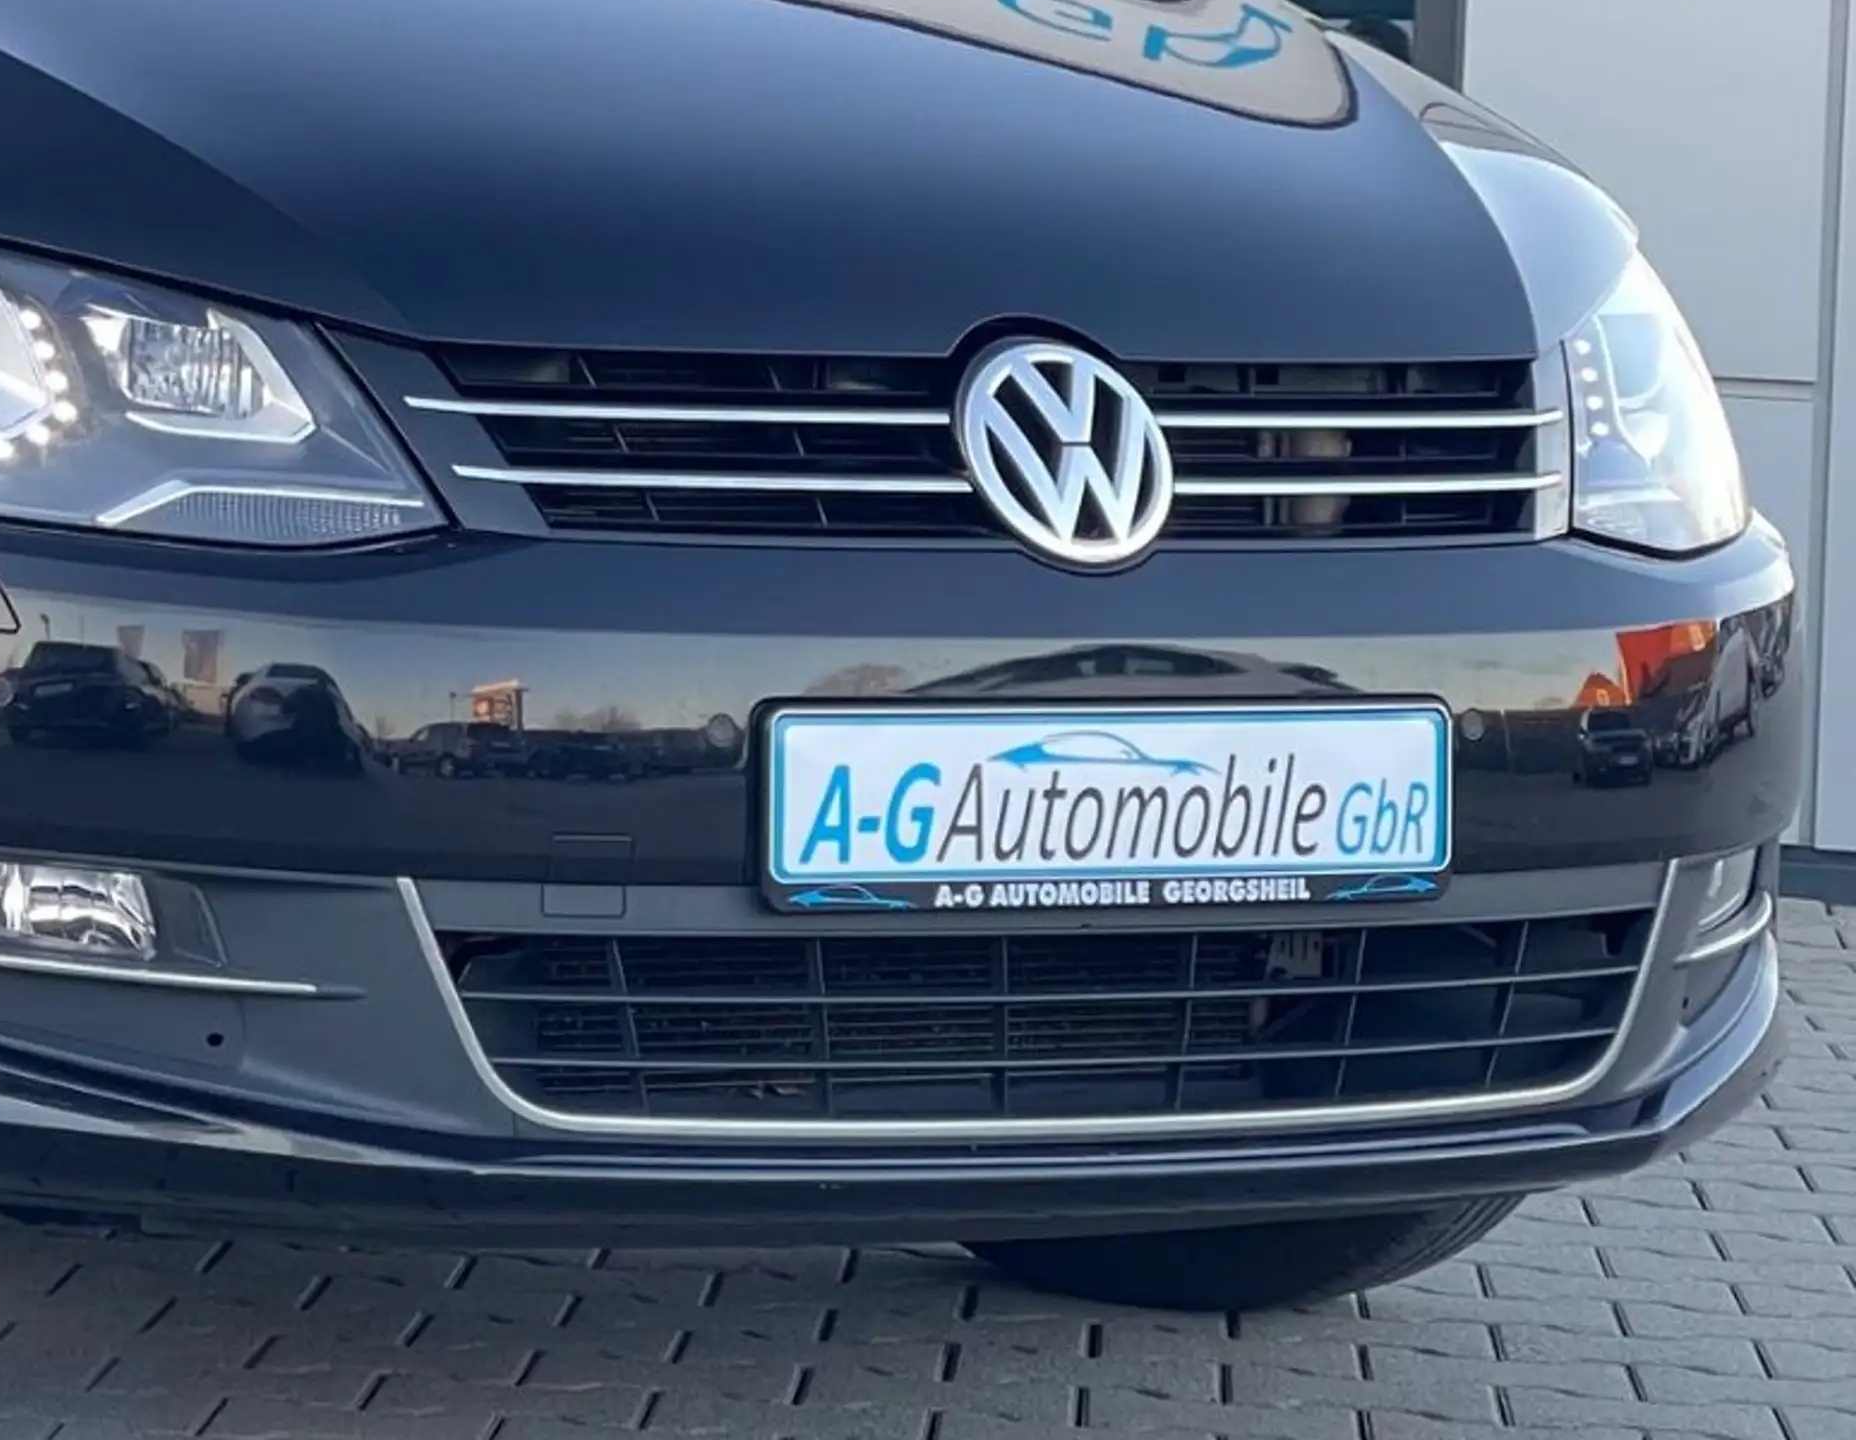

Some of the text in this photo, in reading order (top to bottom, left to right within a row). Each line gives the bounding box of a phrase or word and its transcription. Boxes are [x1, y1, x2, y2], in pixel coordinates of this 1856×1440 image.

[798, 753, 1430, 865] A-G Automobile GbR
[933, 877, 1311, 908] A-G AUTOMOBILE GEORGSHEIL
